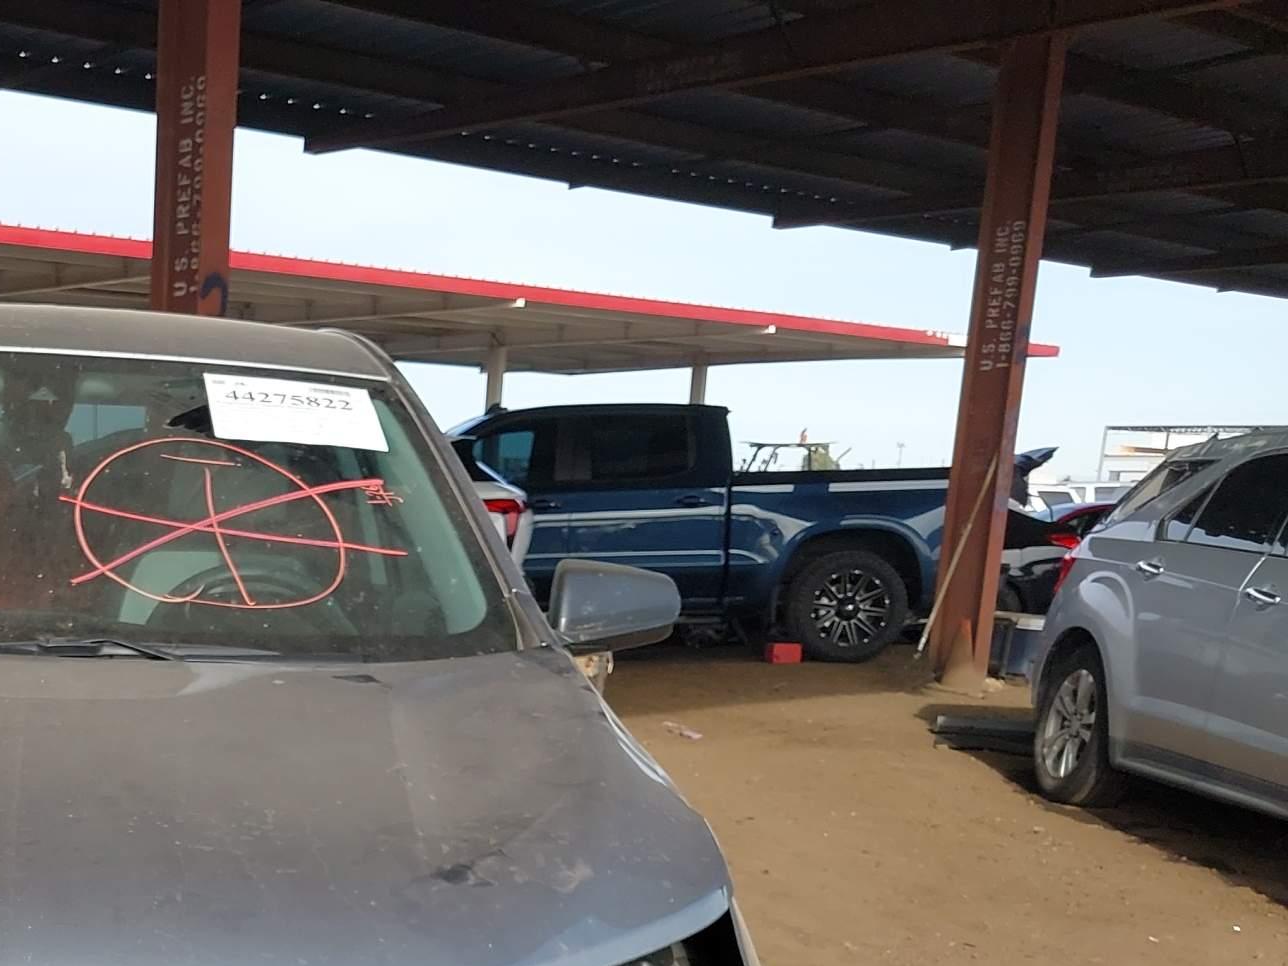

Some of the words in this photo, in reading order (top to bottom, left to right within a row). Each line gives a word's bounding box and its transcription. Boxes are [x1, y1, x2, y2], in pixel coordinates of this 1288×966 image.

[181, 76, 195, 124] INC.
[176, 139, 193, 235] PREFAB
[995, 220, 1012, 254] INC.
[985, 261, 1005, 330] PREFAB
[980, 337, 996, 371] U.S.
[224, 390, 353, 411] 44275822
